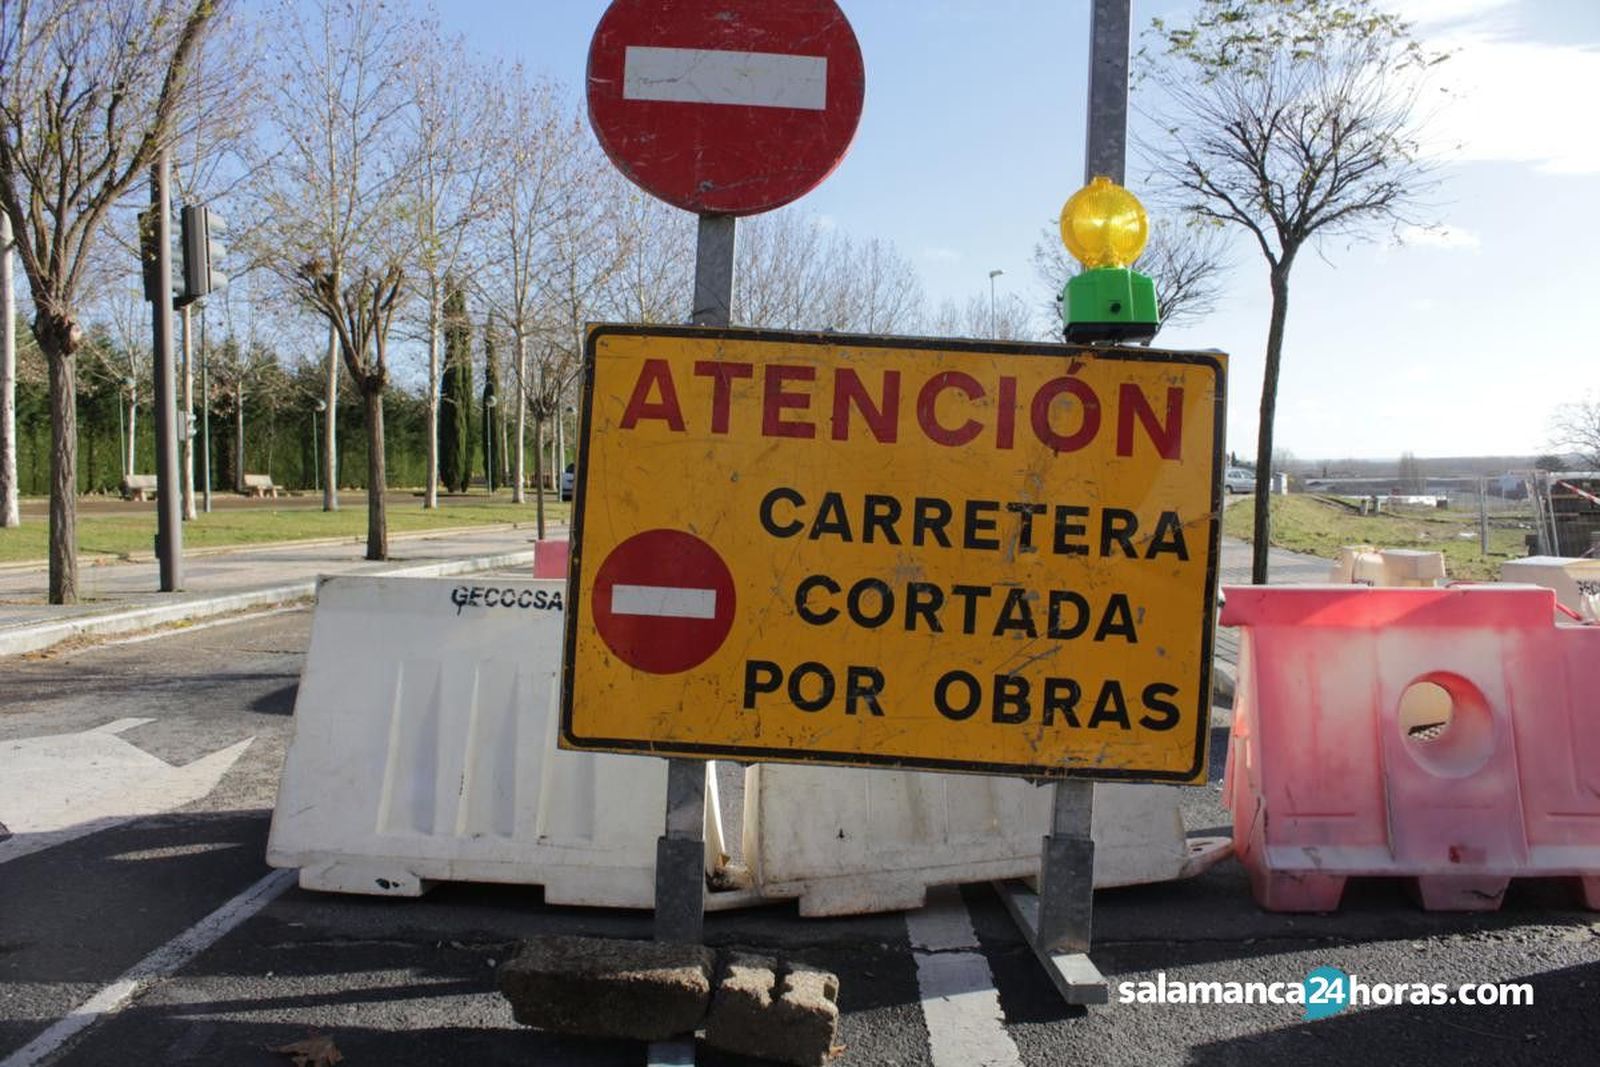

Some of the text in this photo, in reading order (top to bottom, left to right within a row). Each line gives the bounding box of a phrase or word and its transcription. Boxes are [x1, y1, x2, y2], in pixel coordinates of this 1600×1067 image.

[619, 358, 1184, 460] ATENCIÓN
[761, 487, 1190, 562] CARRETERA
[451, 586, 563, 613] GECOCSA
[797, 575, 1138, 643] CORTADA
[743, 660, 1181, 732] POR OBRAS
